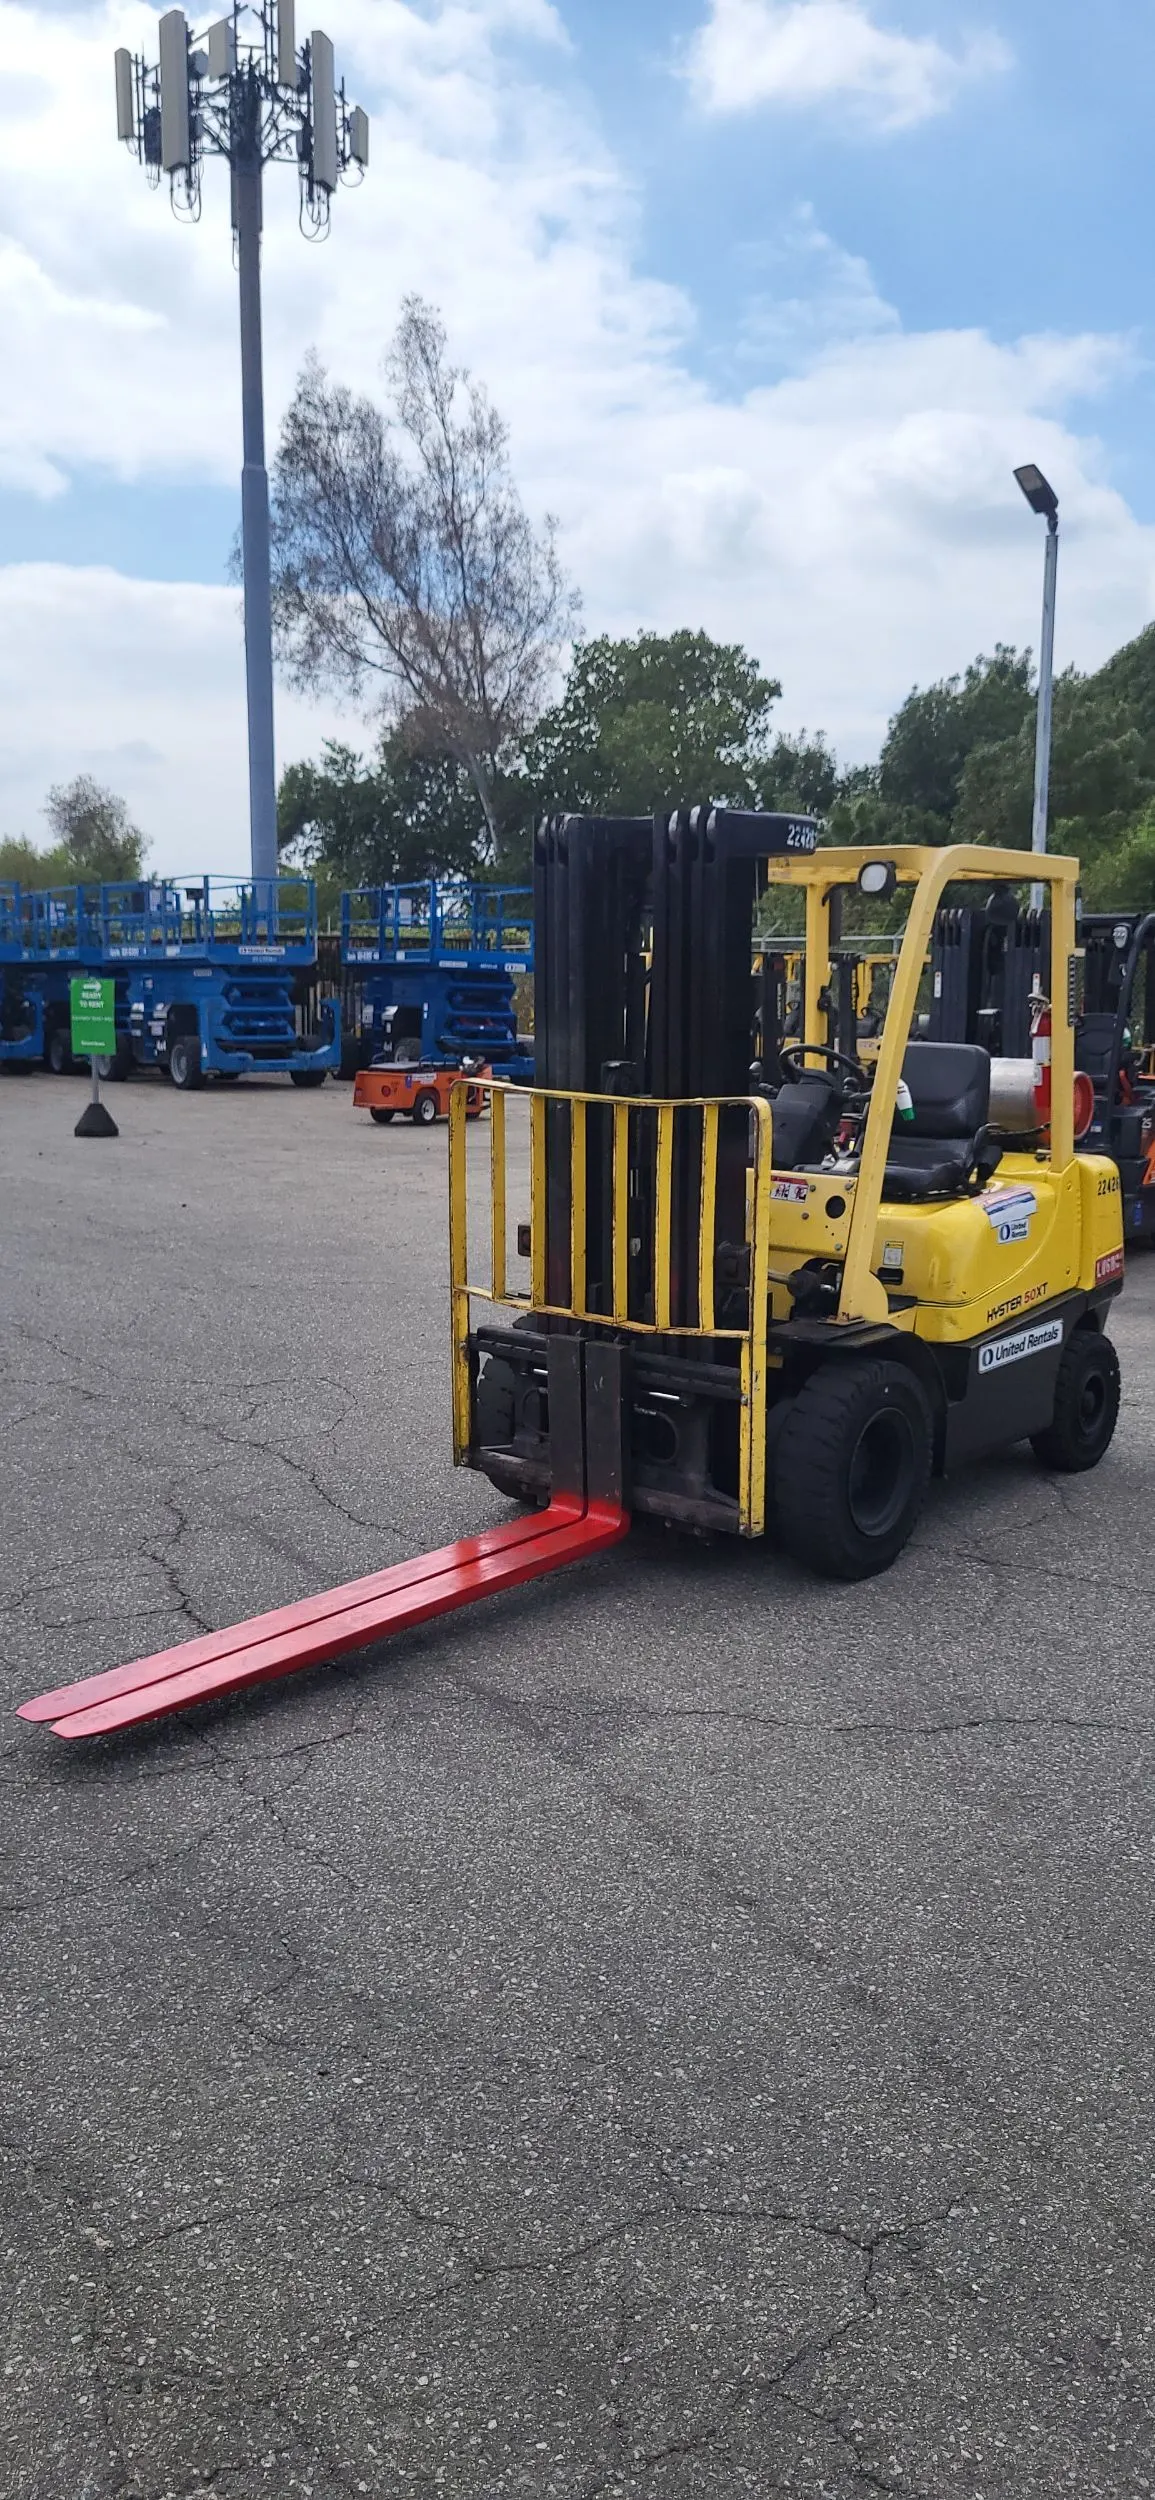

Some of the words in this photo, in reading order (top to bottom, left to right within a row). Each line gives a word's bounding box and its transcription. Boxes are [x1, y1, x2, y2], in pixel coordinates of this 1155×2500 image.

[986, 1295, 1022, 1323] HYSTER
[1023, 1282, 1048, 1304] 50XT
[995, 1336, 1026, 1361] United
[1027, 1325, 1059, 1349] Rentals
